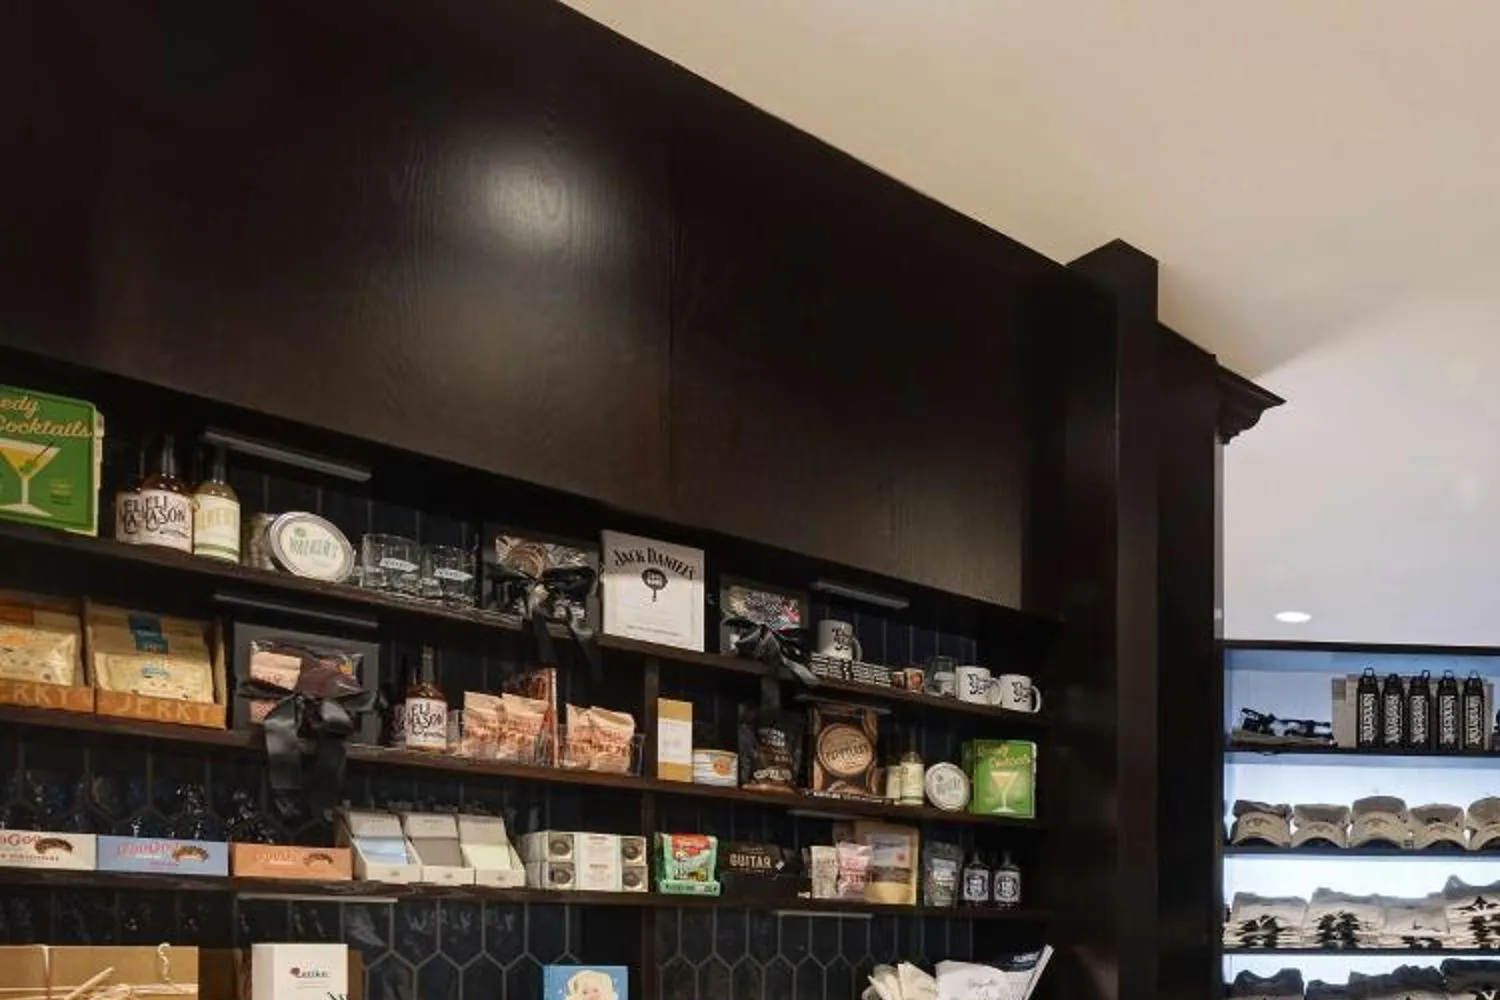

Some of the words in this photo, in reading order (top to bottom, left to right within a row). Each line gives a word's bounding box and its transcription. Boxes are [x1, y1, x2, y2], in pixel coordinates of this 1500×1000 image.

[614, 549, 646, 567] JACK
[647, 547, 697, 581] DANIEL'S
[117, 696, 209, 722] JERKY
[729, 853, 772, 869] GUITAR
